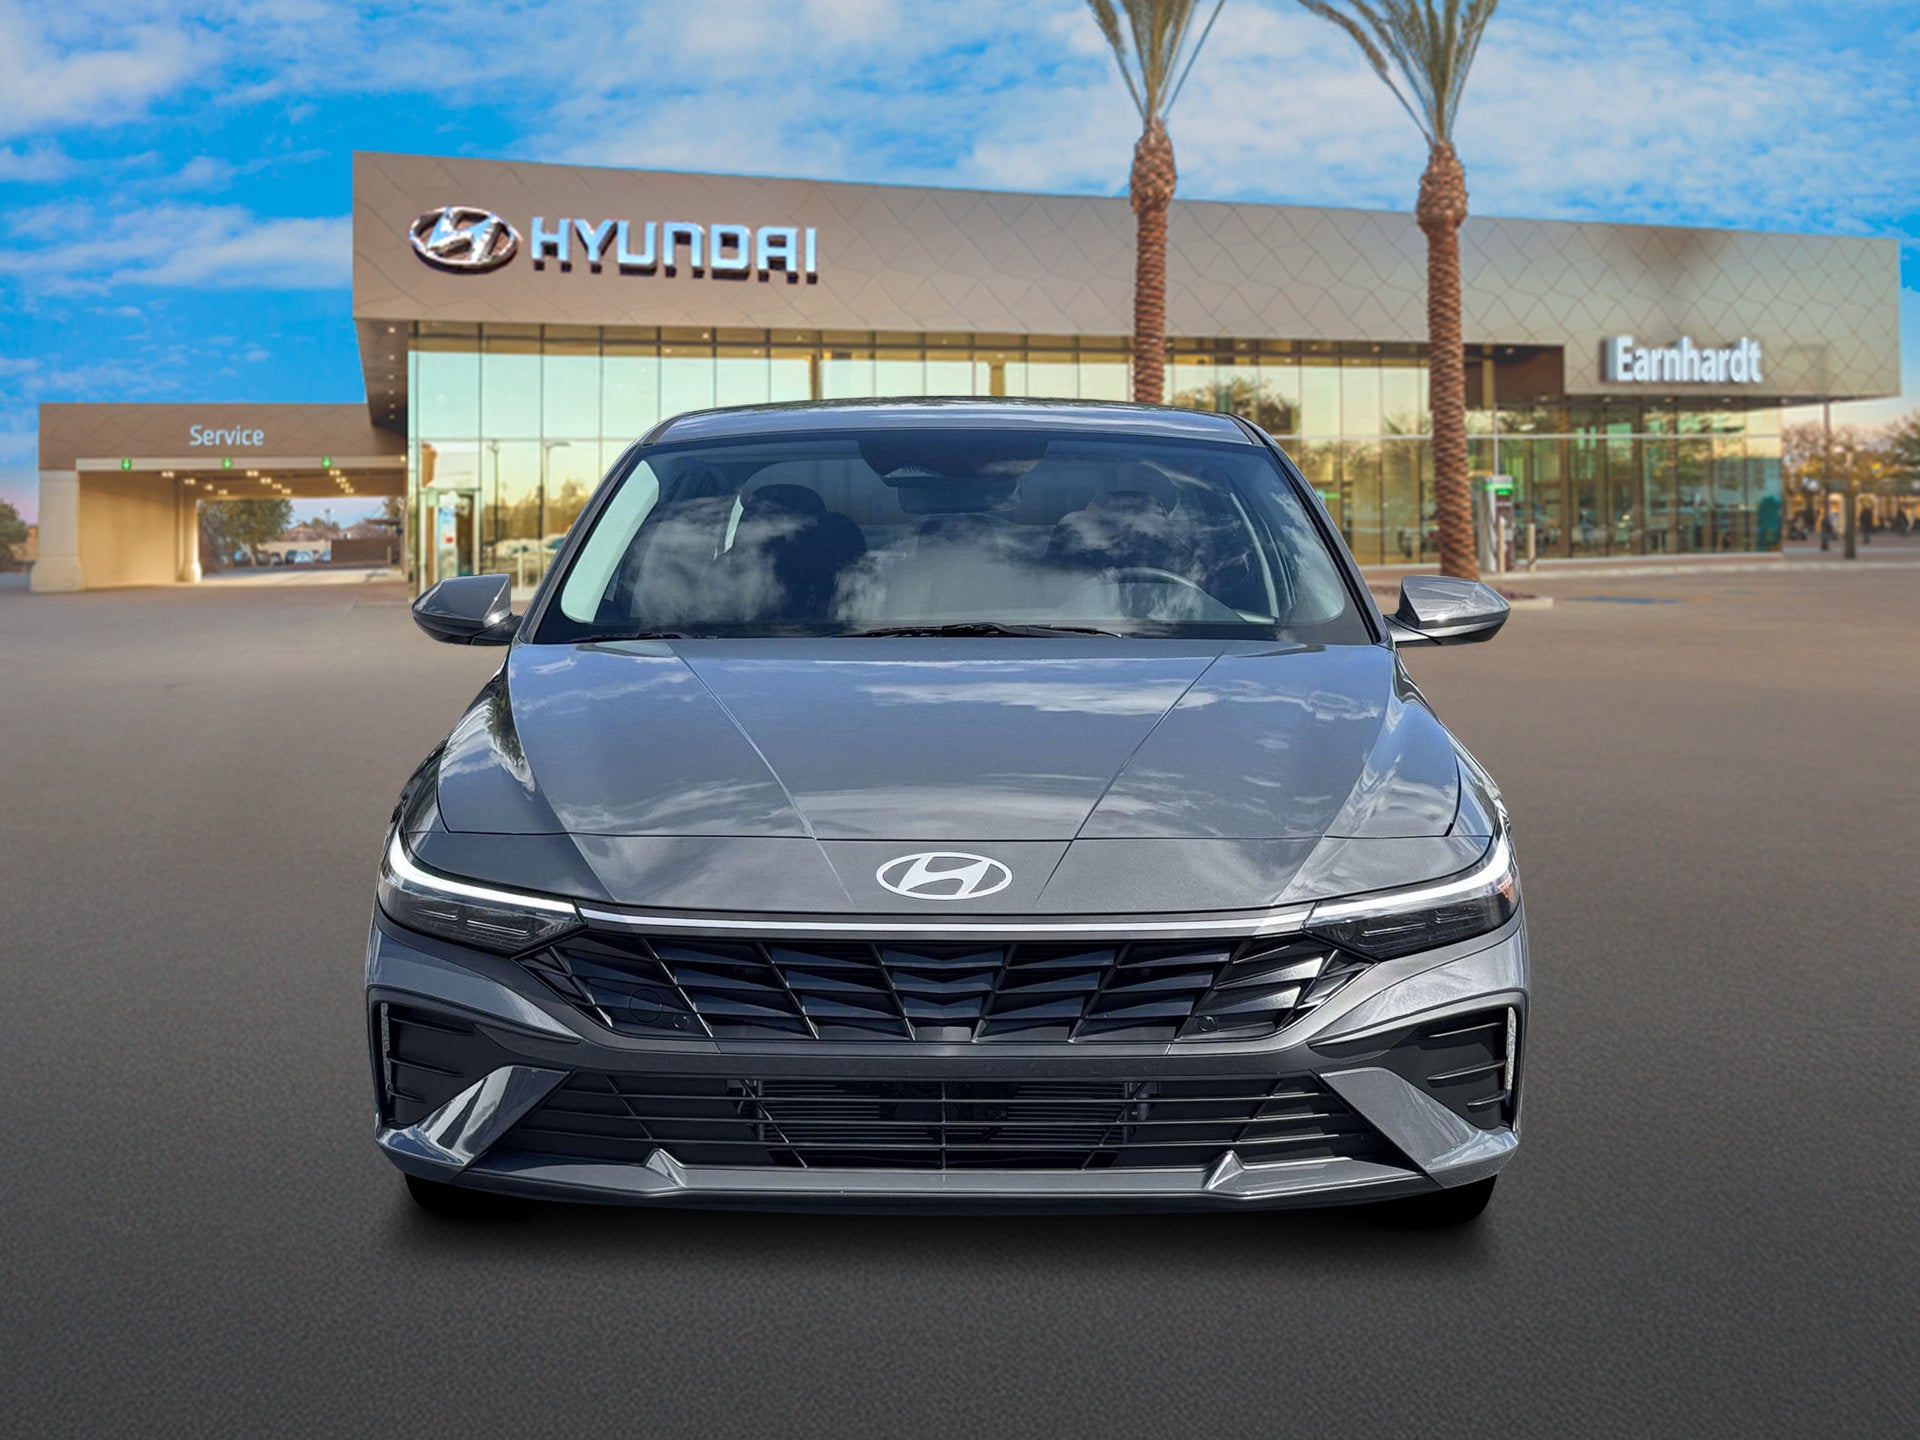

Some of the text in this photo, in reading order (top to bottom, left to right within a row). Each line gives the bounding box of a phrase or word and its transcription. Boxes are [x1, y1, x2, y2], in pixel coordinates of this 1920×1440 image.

[531, 217, 817, 282] HYUNDAI
[1612, 335, 1763, 383] Earnhardt
[189, 424, 265, 446] Service
